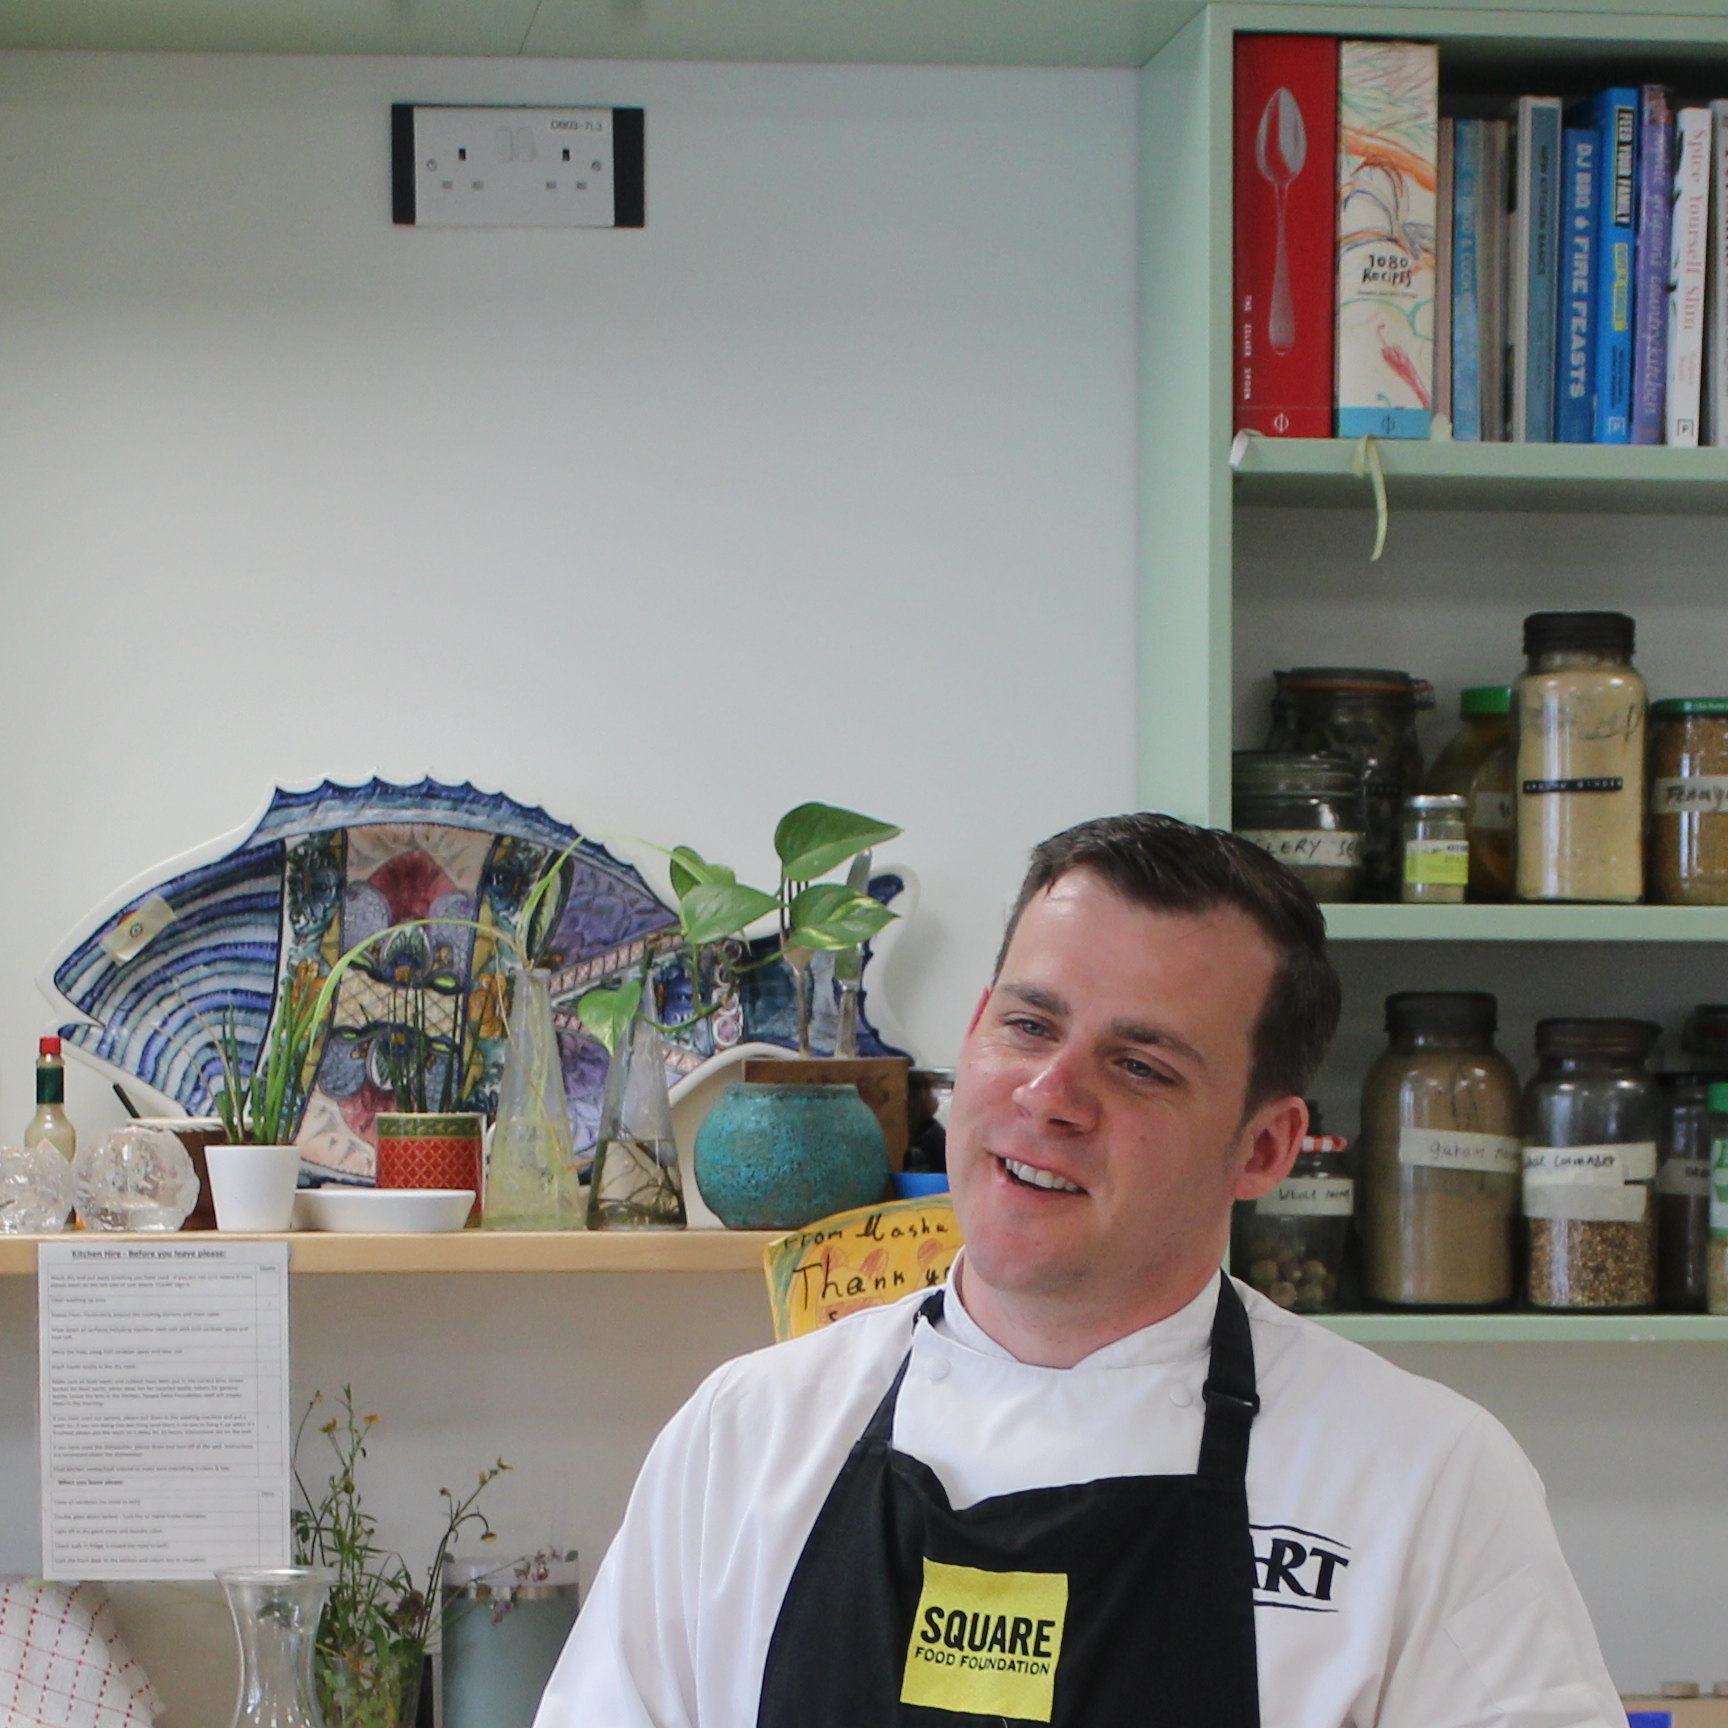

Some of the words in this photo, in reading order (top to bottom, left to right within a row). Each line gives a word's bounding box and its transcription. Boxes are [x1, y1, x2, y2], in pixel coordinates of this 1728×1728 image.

[1618, 112, 1633, 142] FEED
[1576, 143, 1592, 168] DJ
[1617, 144, 1633, 176] YOUR
[1688, 130, 1707, 183] Spice
[1575, 172, 1592, 209] BBQ
[1616, 179, 1632, 225] FAMILY
[1536, 234, 1547, 276] BASICS
[1685, 194, 1705, 275] Yourself
[1369, 254, 1409, 269] 1080
[1573, 236, 1589, 293] FIRE
[1683, 286, 1701, 330] Slim
[1570, 301, 1588, 399] FEASTS
[71, 1249, 102, 1259] Kitchen
[104, 1250, 122, 1259] Hire
[128, 1250, 155, 1259] Before
[156, 1251, 173, 1260] you
[174, 1250, 196, 1259] leave
[792, 1253, 906, 1310] Thank
[919, 1605, 1057, 1659] SQUARE
[913, 1646, 957, 1669] FOOD
[958, 1654, 1051, 1676] FOUNDATION
